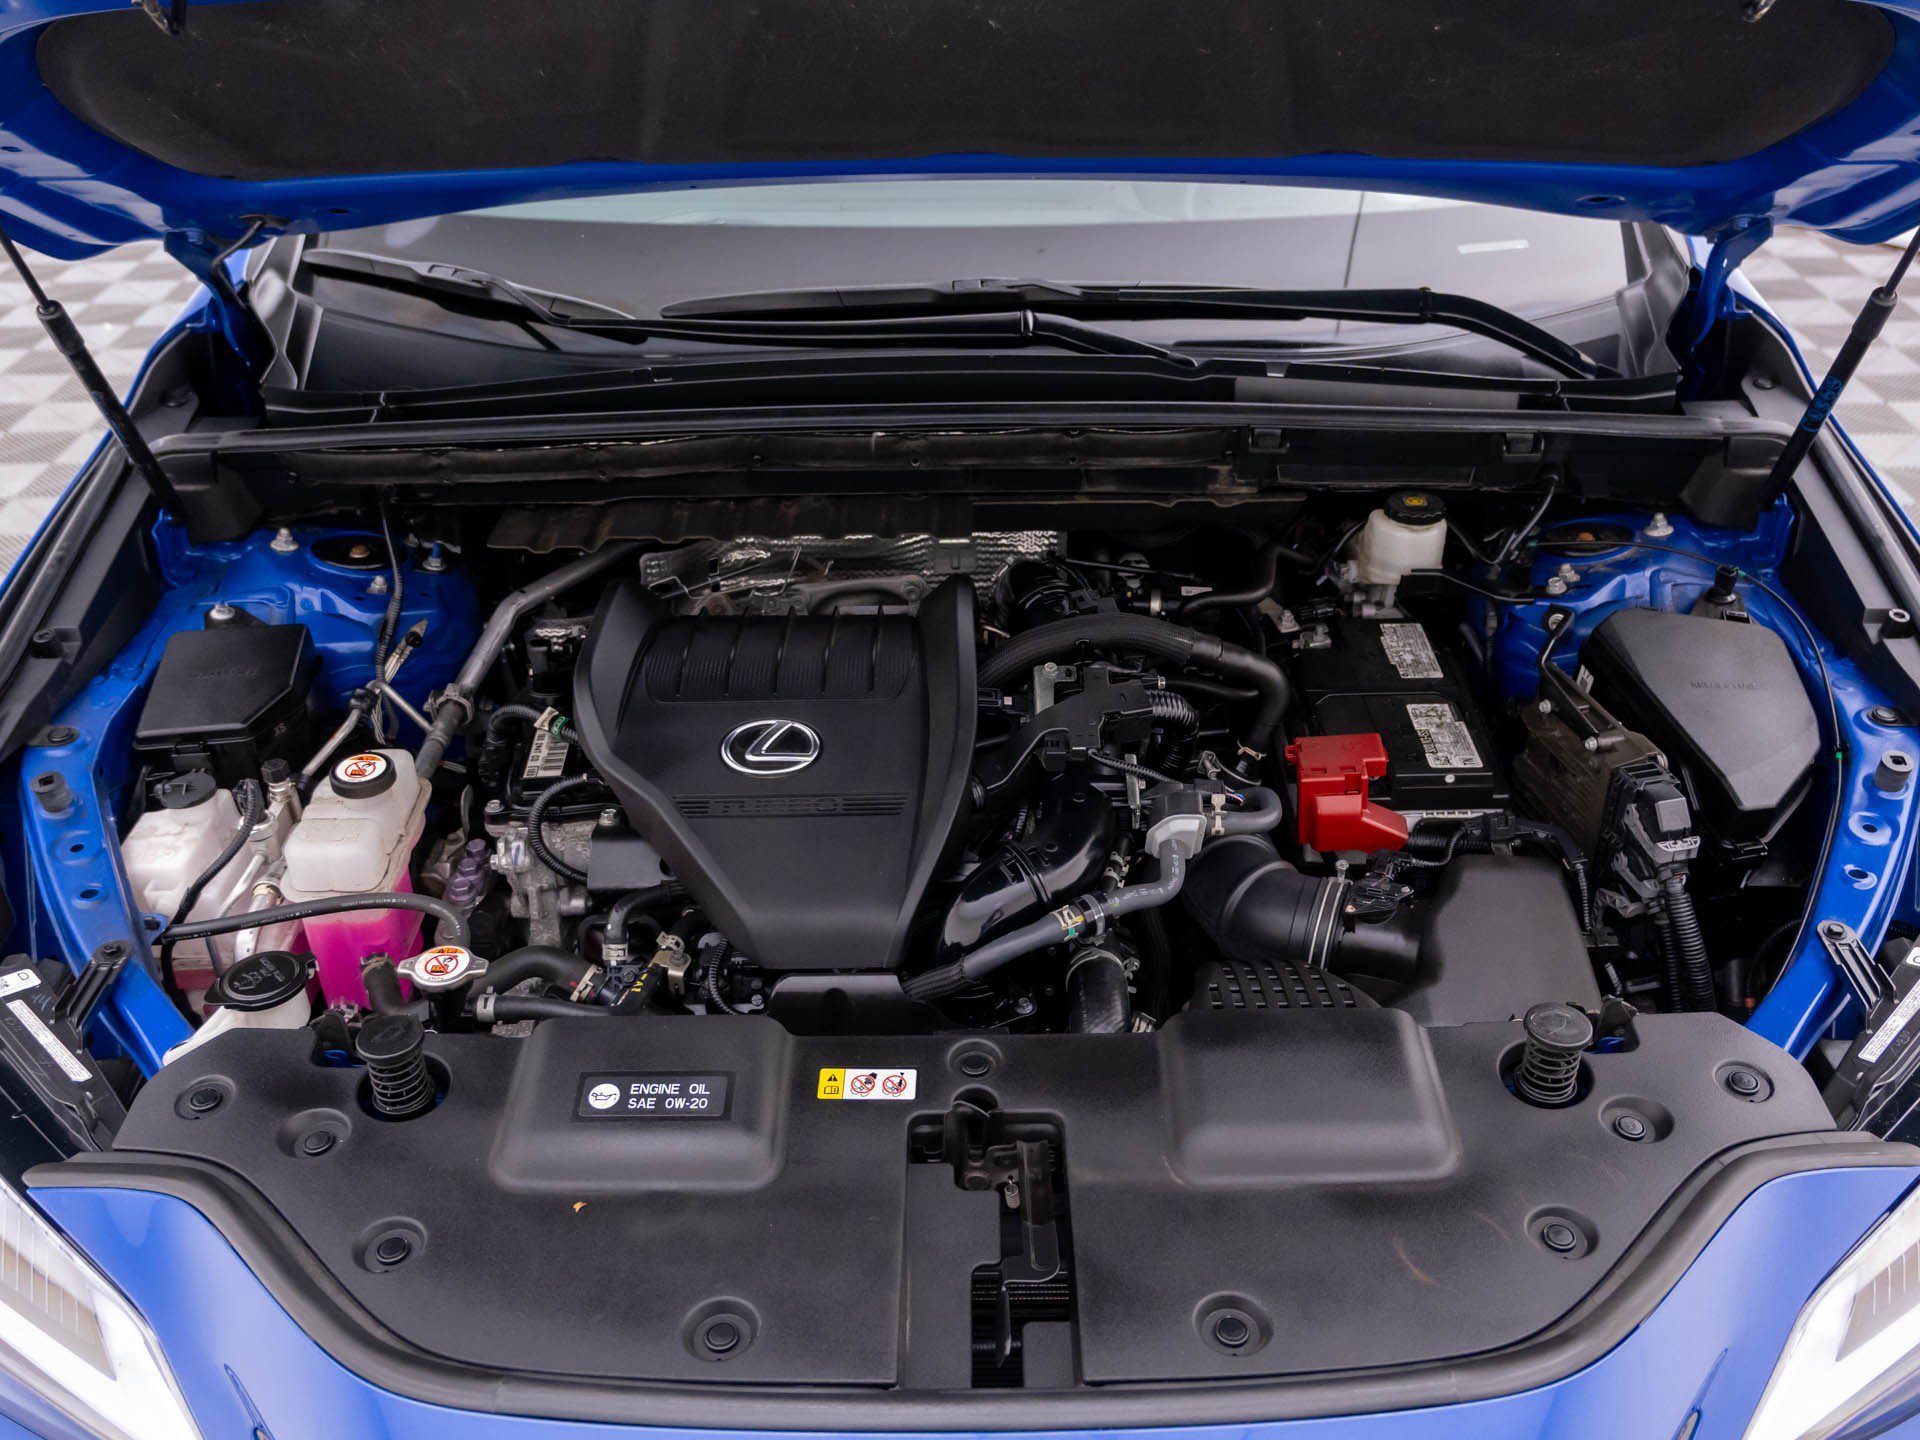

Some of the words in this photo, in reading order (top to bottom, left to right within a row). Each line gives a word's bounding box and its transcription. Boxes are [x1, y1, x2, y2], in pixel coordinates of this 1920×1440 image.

[630, 1083, 681, 1095] ENGINE
[688, 1083, 711, 1095] OIL
[627, 1097, 656, 1109] SAE
[664, 1097, 708, 1109] 0W-20
